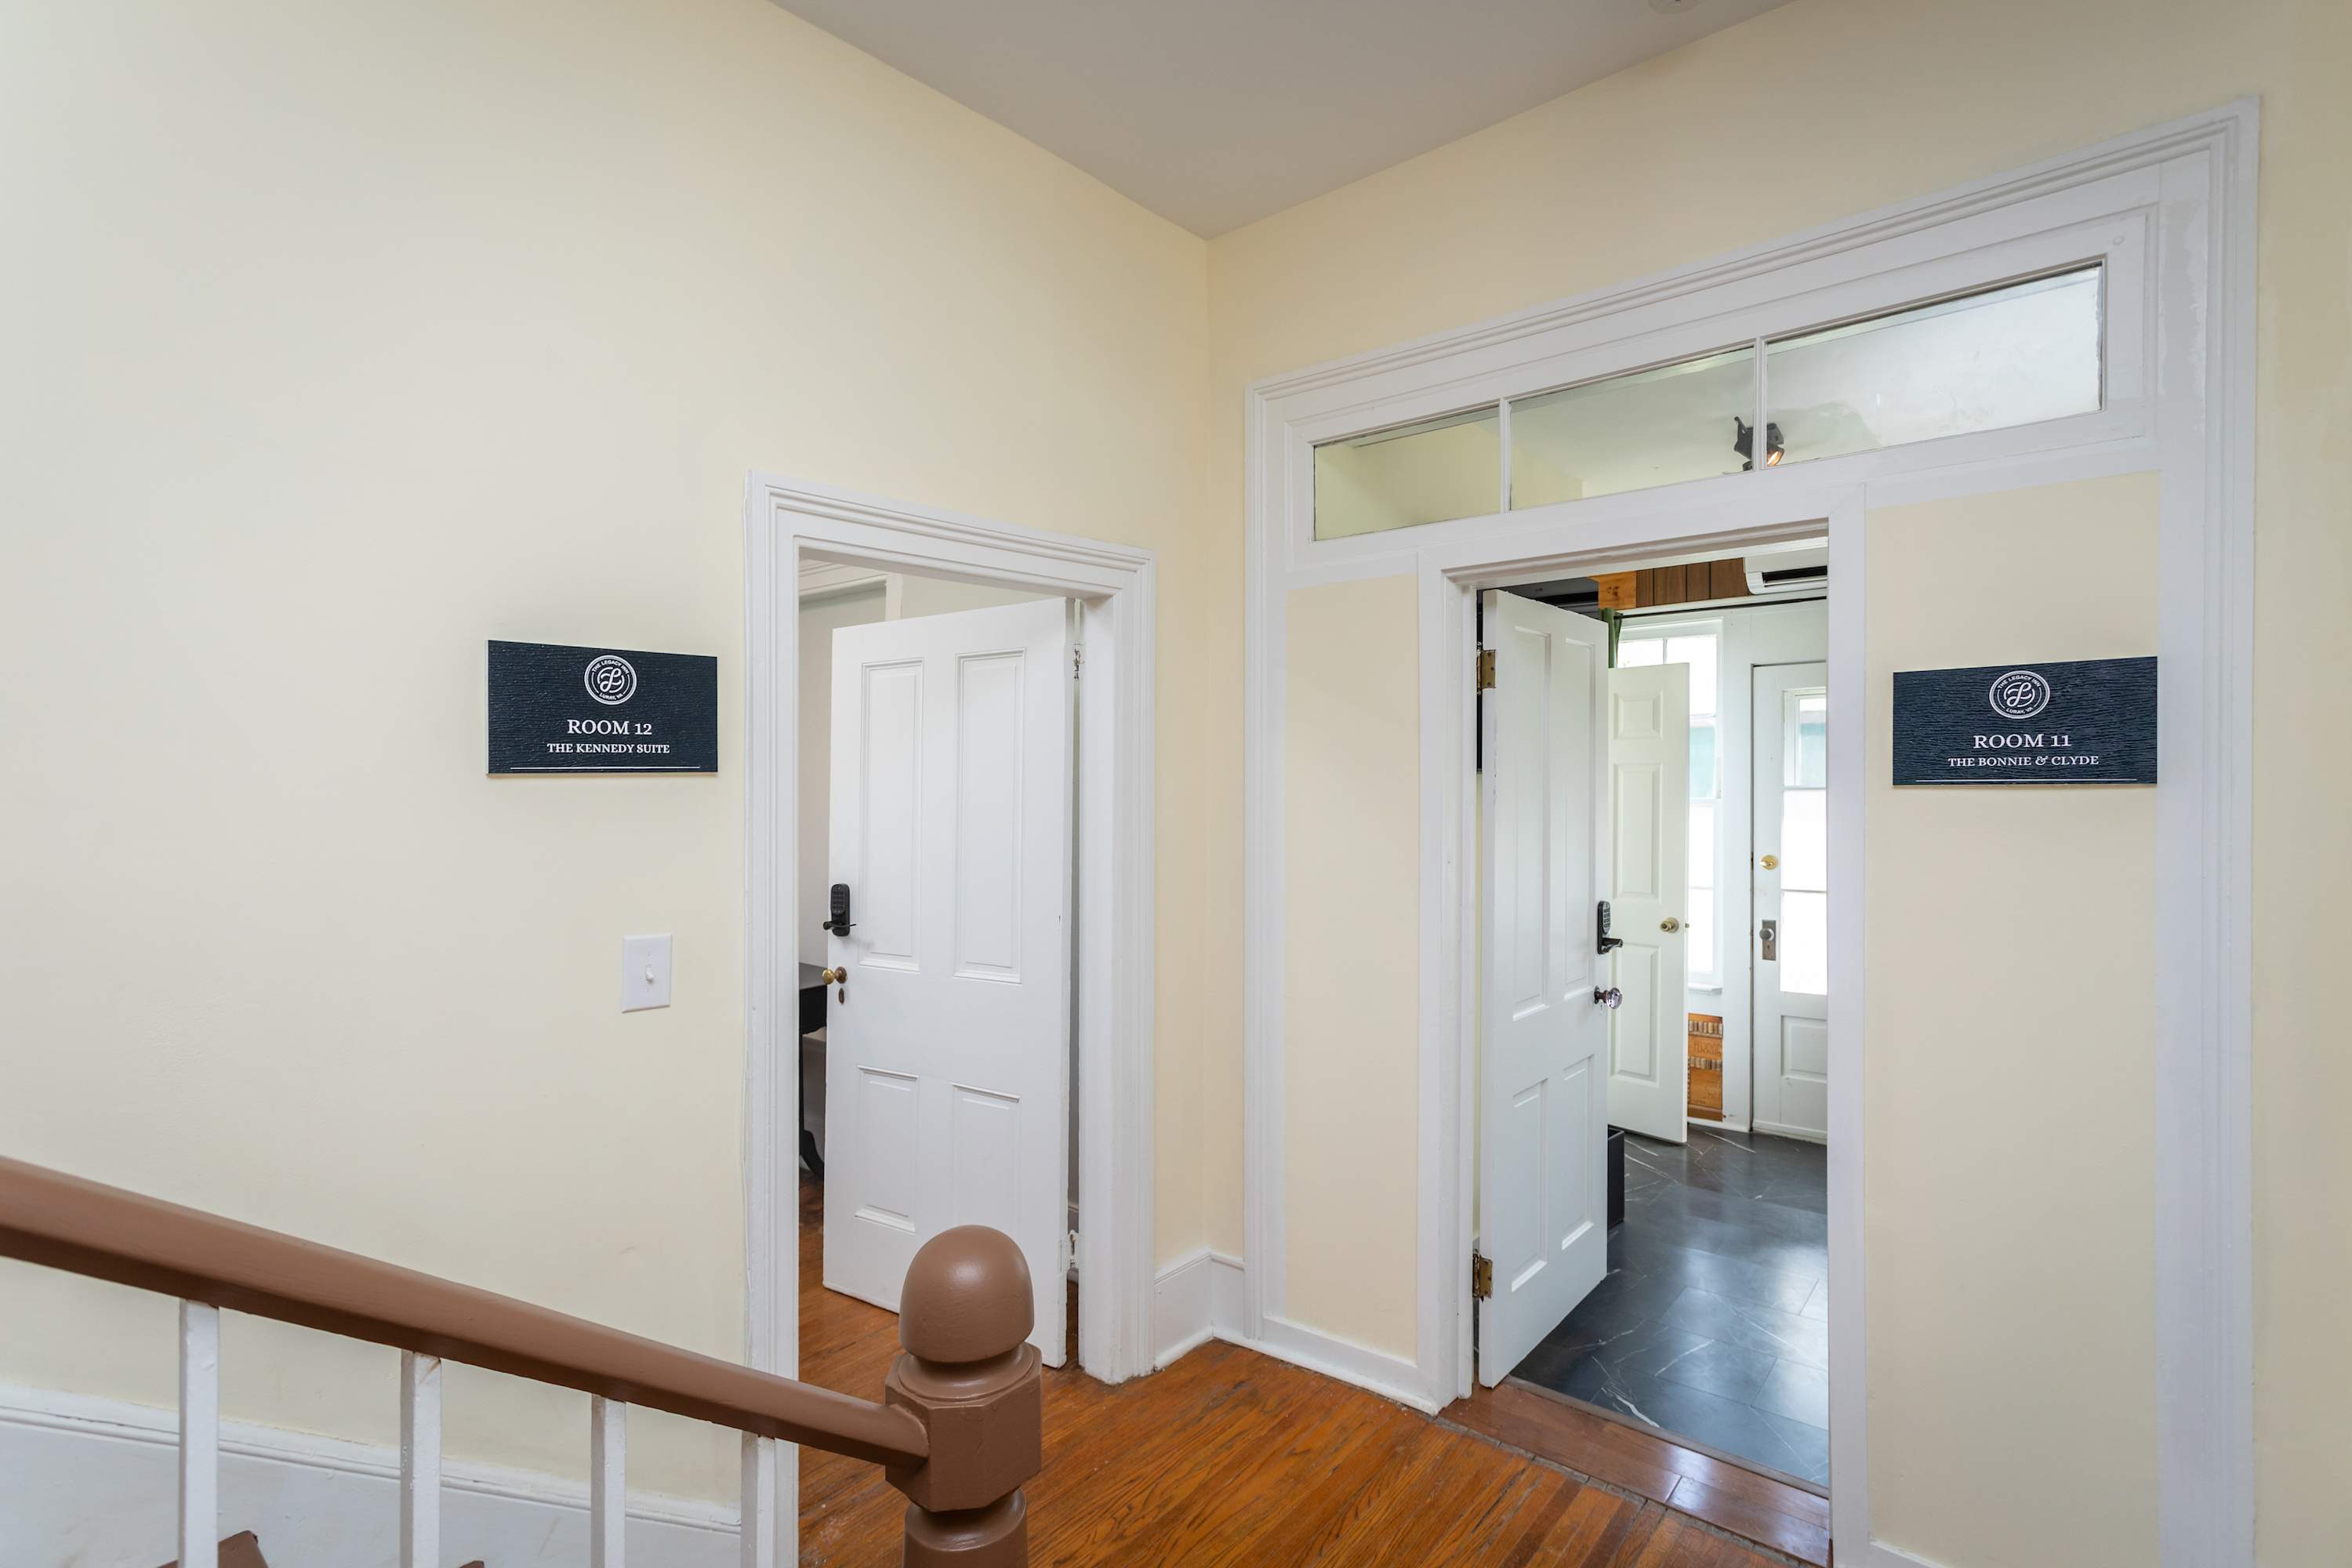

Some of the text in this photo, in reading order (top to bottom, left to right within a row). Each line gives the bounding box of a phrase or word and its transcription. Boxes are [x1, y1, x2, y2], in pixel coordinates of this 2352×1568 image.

[592, 662, 602, 672] THE
[621, 665, 630, 674] INN
[1997, 680, 2009, 689] THE
[2031, 678, 2042, 687] INN
[567, 719, 652, 735] ROOM 12
[1973, 734, 2071, 749] ROOM 11
[547, 743, 670, 753] THE KENNEDY SUITE
[1948, 756, 2099, 767] THE BONNIE & CLYDE
